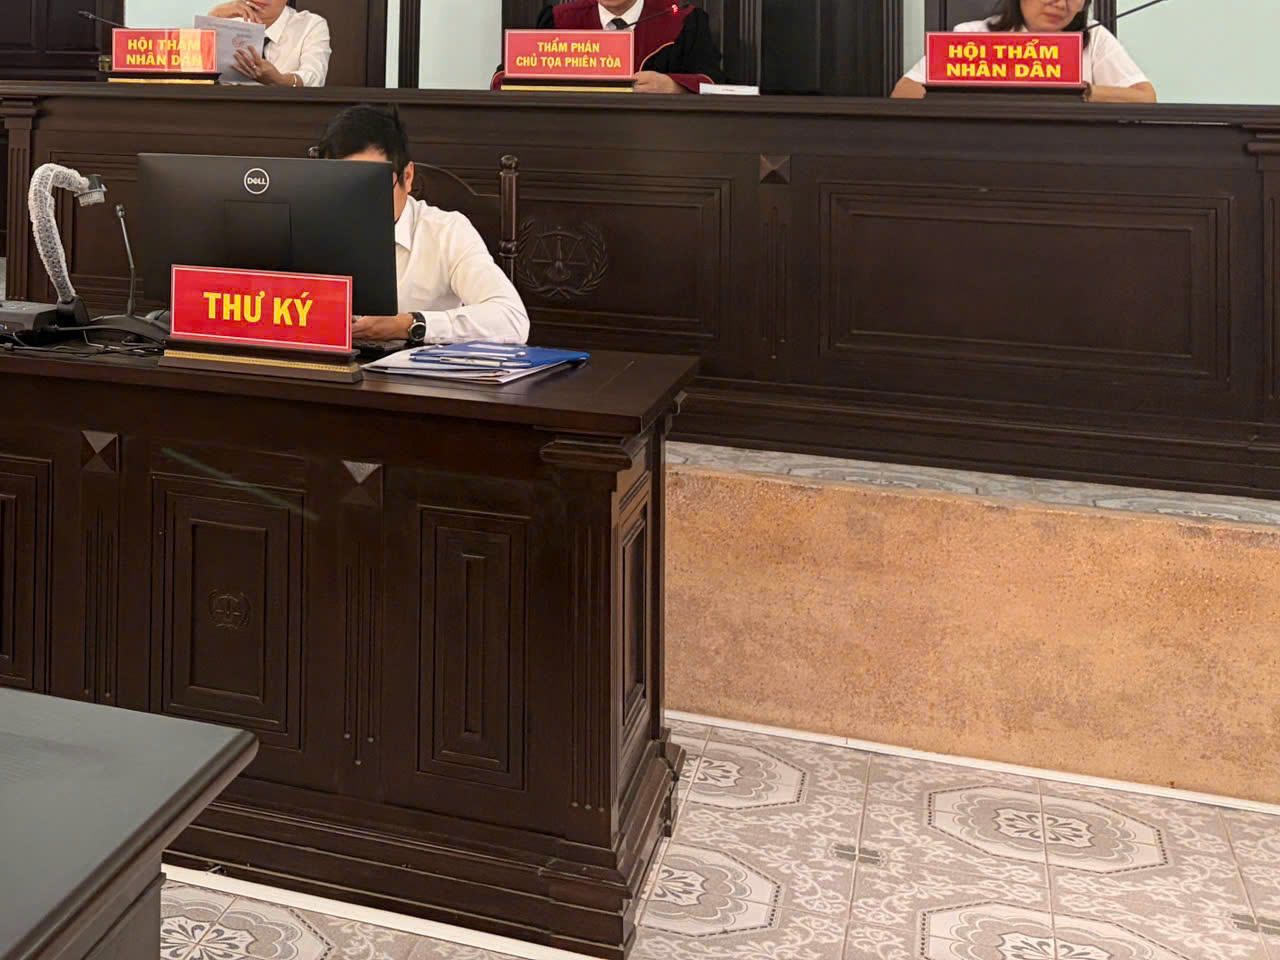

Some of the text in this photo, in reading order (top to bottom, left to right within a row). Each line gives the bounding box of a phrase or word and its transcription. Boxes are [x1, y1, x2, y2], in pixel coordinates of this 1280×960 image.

[128, 37, 153, 52] HỘI
[571, 40, 600, 53] PHÁN
[948, 39, 1059, 61] HỘI THẨM
[126, 52, 168, 65] NHÂN
[516, 53, 621, 69] CHỦ TỌA PHIÊN TÒA
[946, 60, 1061, 78] NHÂN DÂN
[247, 177, 267, 185] DELL
[203, 291, 313, 327] THƯ KÝ
